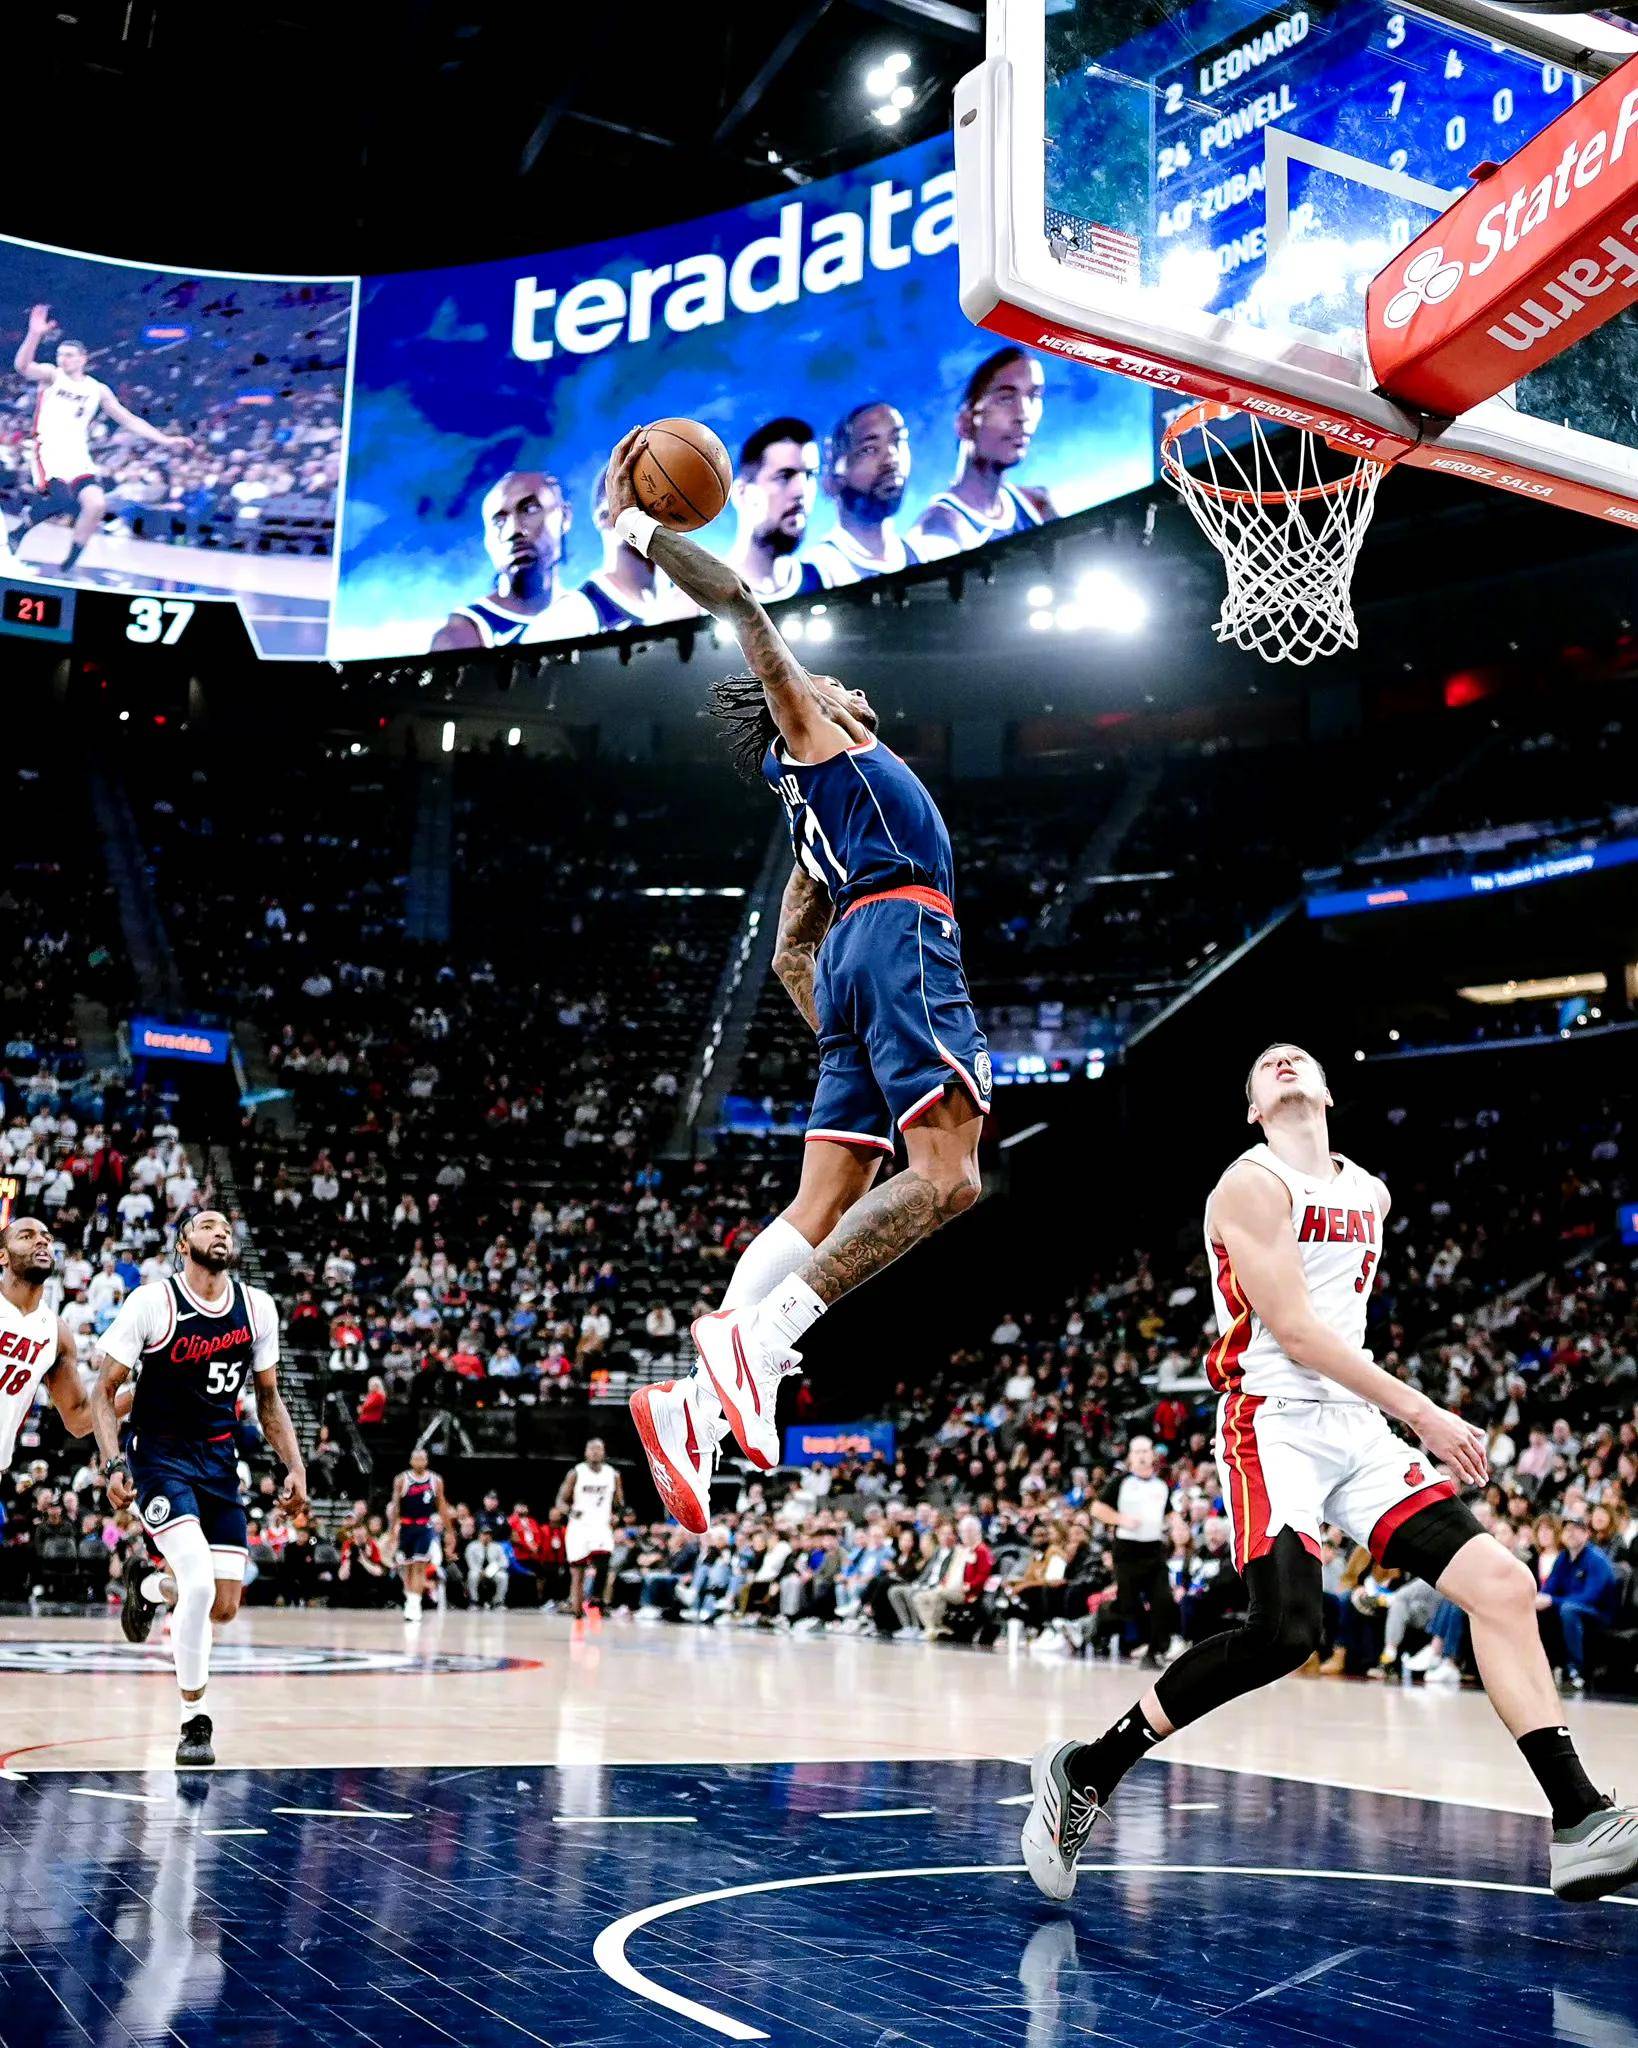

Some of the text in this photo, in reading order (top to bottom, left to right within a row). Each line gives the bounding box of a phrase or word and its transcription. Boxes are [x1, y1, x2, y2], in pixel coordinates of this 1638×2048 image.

[1386, 14, 1406, 49] 3
[1164, 11, 1309, 115] 2 LEONARD
[1200, 84, 1297, 157] POWELL
[1445, 115, 1466, 151] 0
[1492, 88, 1513, 124] 0
[1199, 161, 1266, 221] ZUBA
[1469, 130, 1607, 276] State
[511, 169, 959, 362] teradata
[1036, 333, 1184, 386] HERDEZ SALSA
[1241, 397, 1314, 426] HERDEZ
[1314, 420, 1376, 449] SALSA
[1429, 458, 1555, 497] HERDEZ SALSA
[17, 597, 195, 645] 21 37
[1297, 1203, 1376, 1244] HEAT
[1354, 1249, 1377, 1294] 5
[0, 1330, 51, 1366] EAT
[170, 1325, 251, 1364] Clippers
[0, 1364, 32, 1396] 18
[206, 1361, 243, 1394] 55
